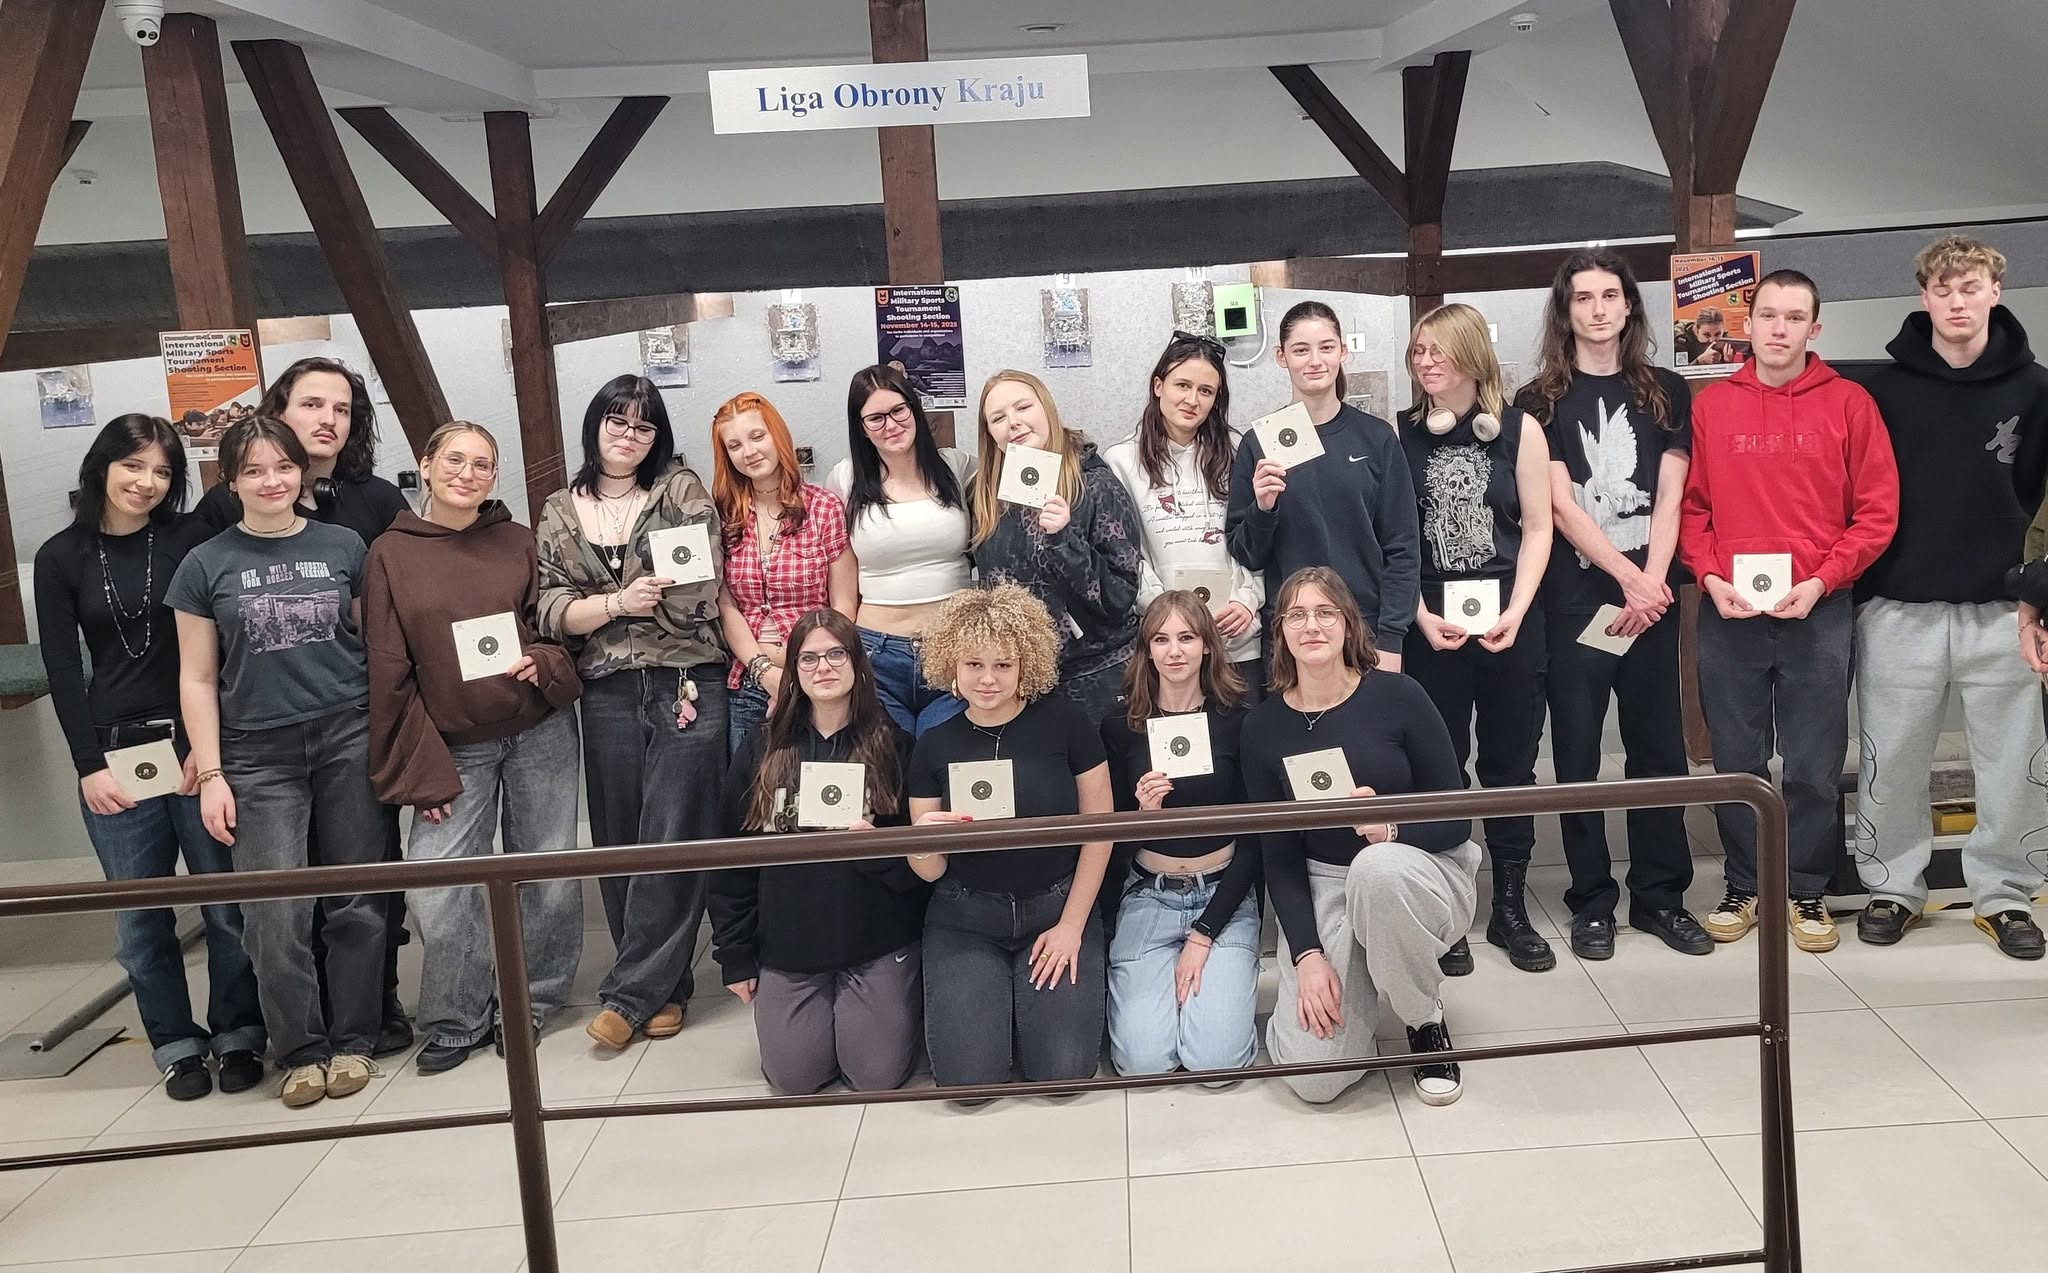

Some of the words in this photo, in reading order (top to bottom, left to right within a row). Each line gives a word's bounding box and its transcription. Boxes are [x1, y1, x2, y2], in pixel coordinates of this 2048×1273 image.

[756, 86, 824, 117] Liga
[833, 82, 946, 110] Obrony
[956, 75, 1045, 108] Kraju
[1678, 265, 1723, 285] International
[1689, 276, 1715, 289] Military
[1717, 268, 1741, 280] Sports
[893, 288, 942, 296] International
[1677, 281, 1720, 299] Tournament
[1692, 286, 1725, 301] Shooting
[1725, 278, 1754, 290] Section
[890, 297, 920, 305] Military
[895, 305, 942, 313] Tournament
[886, 313, 921, 321] Shooting
[164, 340, 226, 349] International
[1351, 337, 1358, 350] 1
[166, 349, 203, 357] Military
[205, 348, 234, 356] Sports
[167, 357, 225, 365] Tournament
[168, 365, 212, 374] Shooting
[214, 364, 247, 372] Section
[268, 563, 288, 575] WILD
[295, 561, 328, 571] ACOUSTIC
[242, 577, 262, 590] YORK
